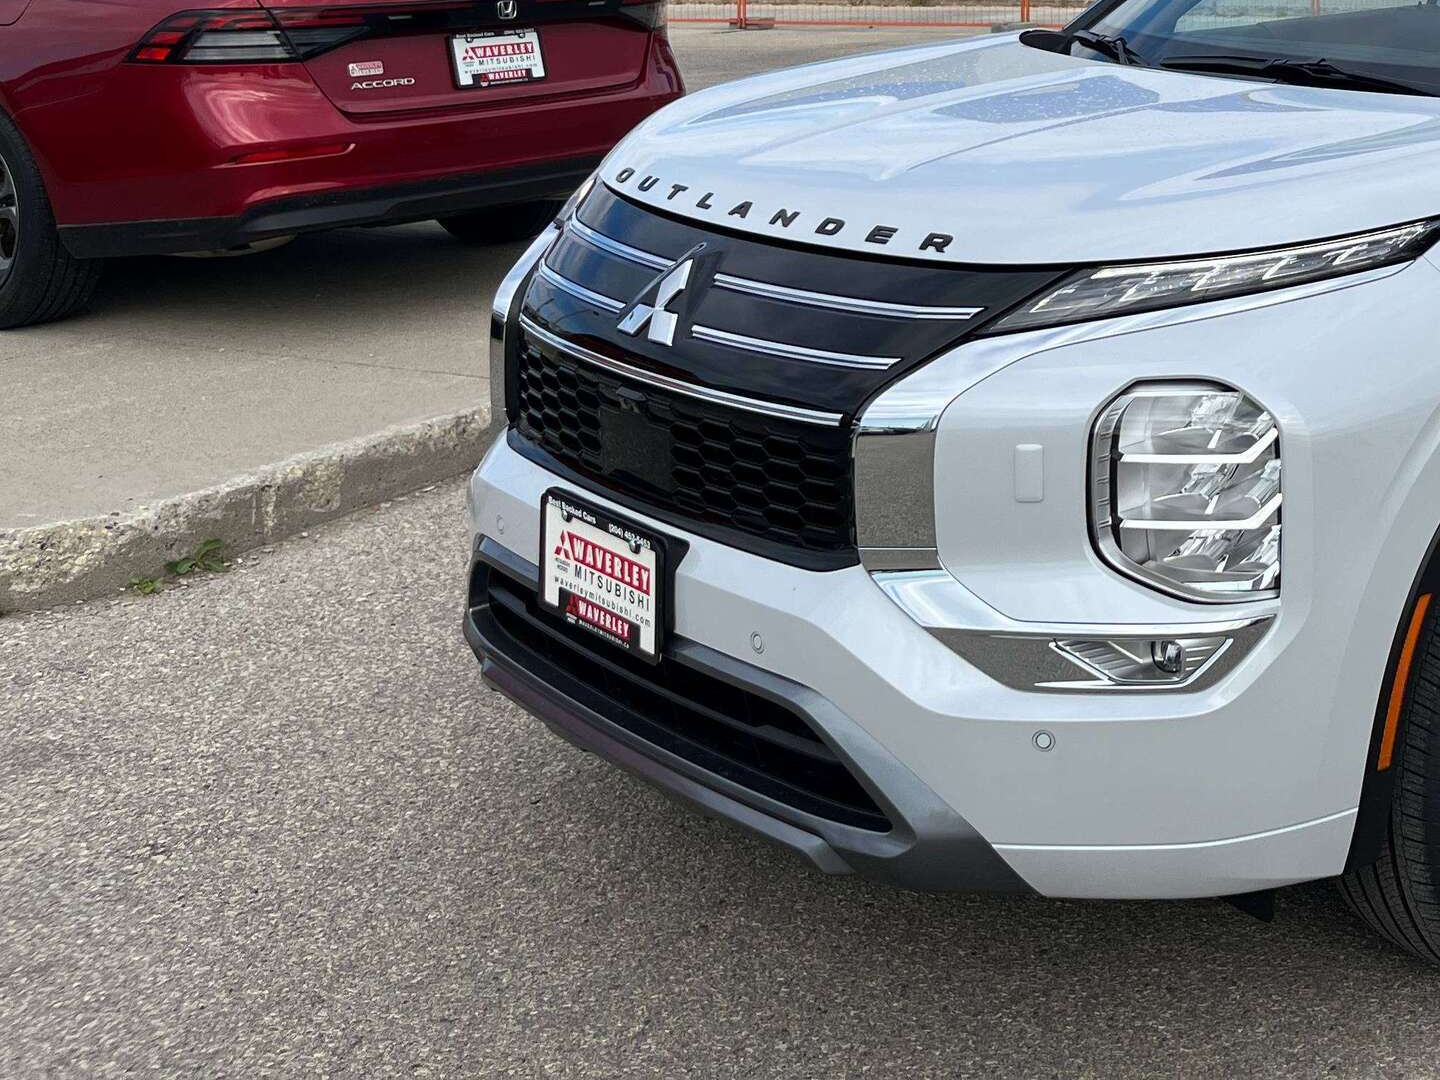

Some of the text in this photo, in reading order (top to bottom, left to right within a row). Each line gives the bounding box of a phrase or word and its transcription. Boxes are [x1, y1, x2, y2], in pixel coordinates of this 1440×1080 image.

[474, 42, 533, 58] WAVERLEY
[478, 55, 536, 66] MITSUBISHI
[351, 77, 415, 90] ACCORD
[488, 69, 526, 81] WAVERLEY
[615, 167, 954, 253] OUTLANDER
[572, 537, 649, 591] WAVERLEY
[574, 564, 650, 612] MITSUBISHI
[578, 600, 630, 638] WAVERLEY
